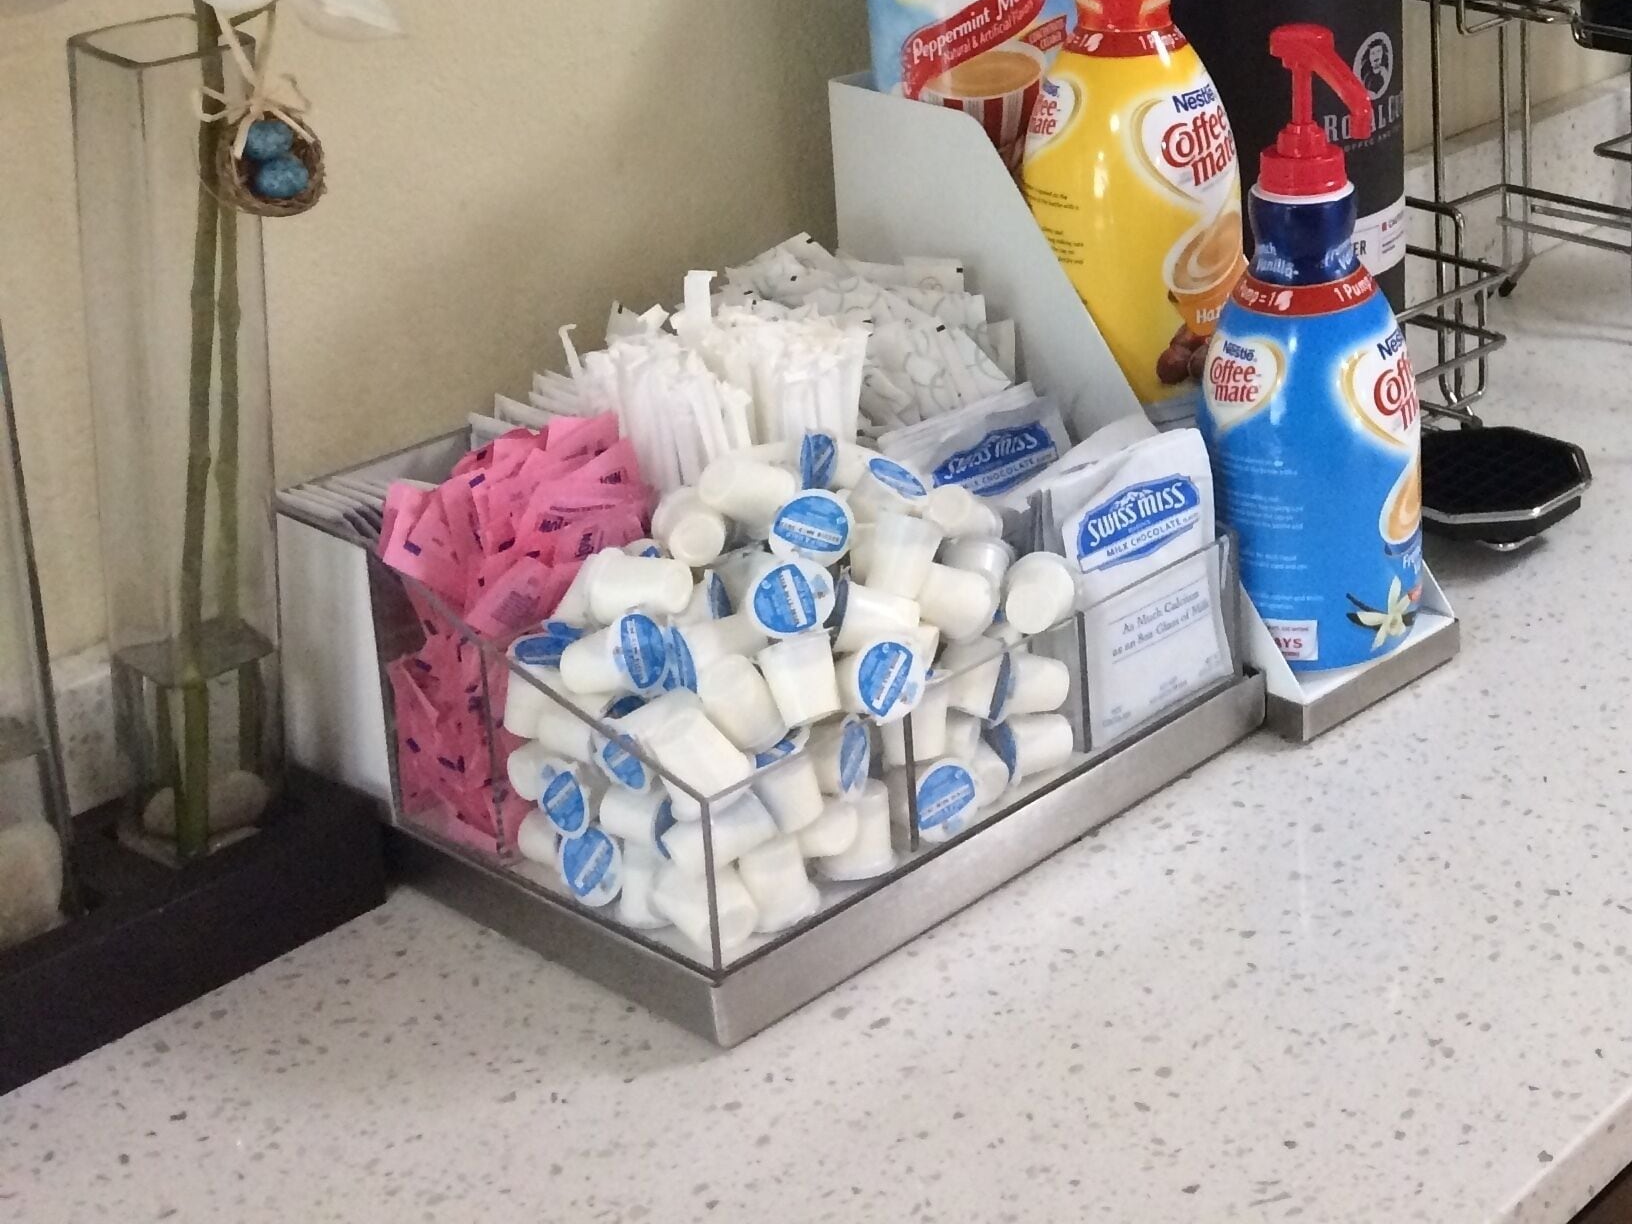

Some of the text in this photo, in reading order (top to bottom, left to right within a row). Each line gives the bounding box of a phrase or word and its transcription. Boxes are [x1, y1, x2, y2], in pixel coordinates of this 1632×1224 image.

[912, 6, 991, 64] Peppermint
[942, 38, 971, 64] Natural
[972, 35, 978, 48] &
[979, 16, 1012, 45] Artificial
[1343, 275, 1372, 300] Pump
[1214, 382, 1259, 403] mate
[1087, 502, 1137, 547] SWISS
[1138, 482, 1186, 519] MISS
[1106, 542, 1128, 557] MILK
[1130, 517, 1180, 548] CHOCOLATE
[1122, 590, 1200, 635] As Much Calcium
[1124, 639, 1136, 650] an
[1155, 618, 1180, 640] Glass
